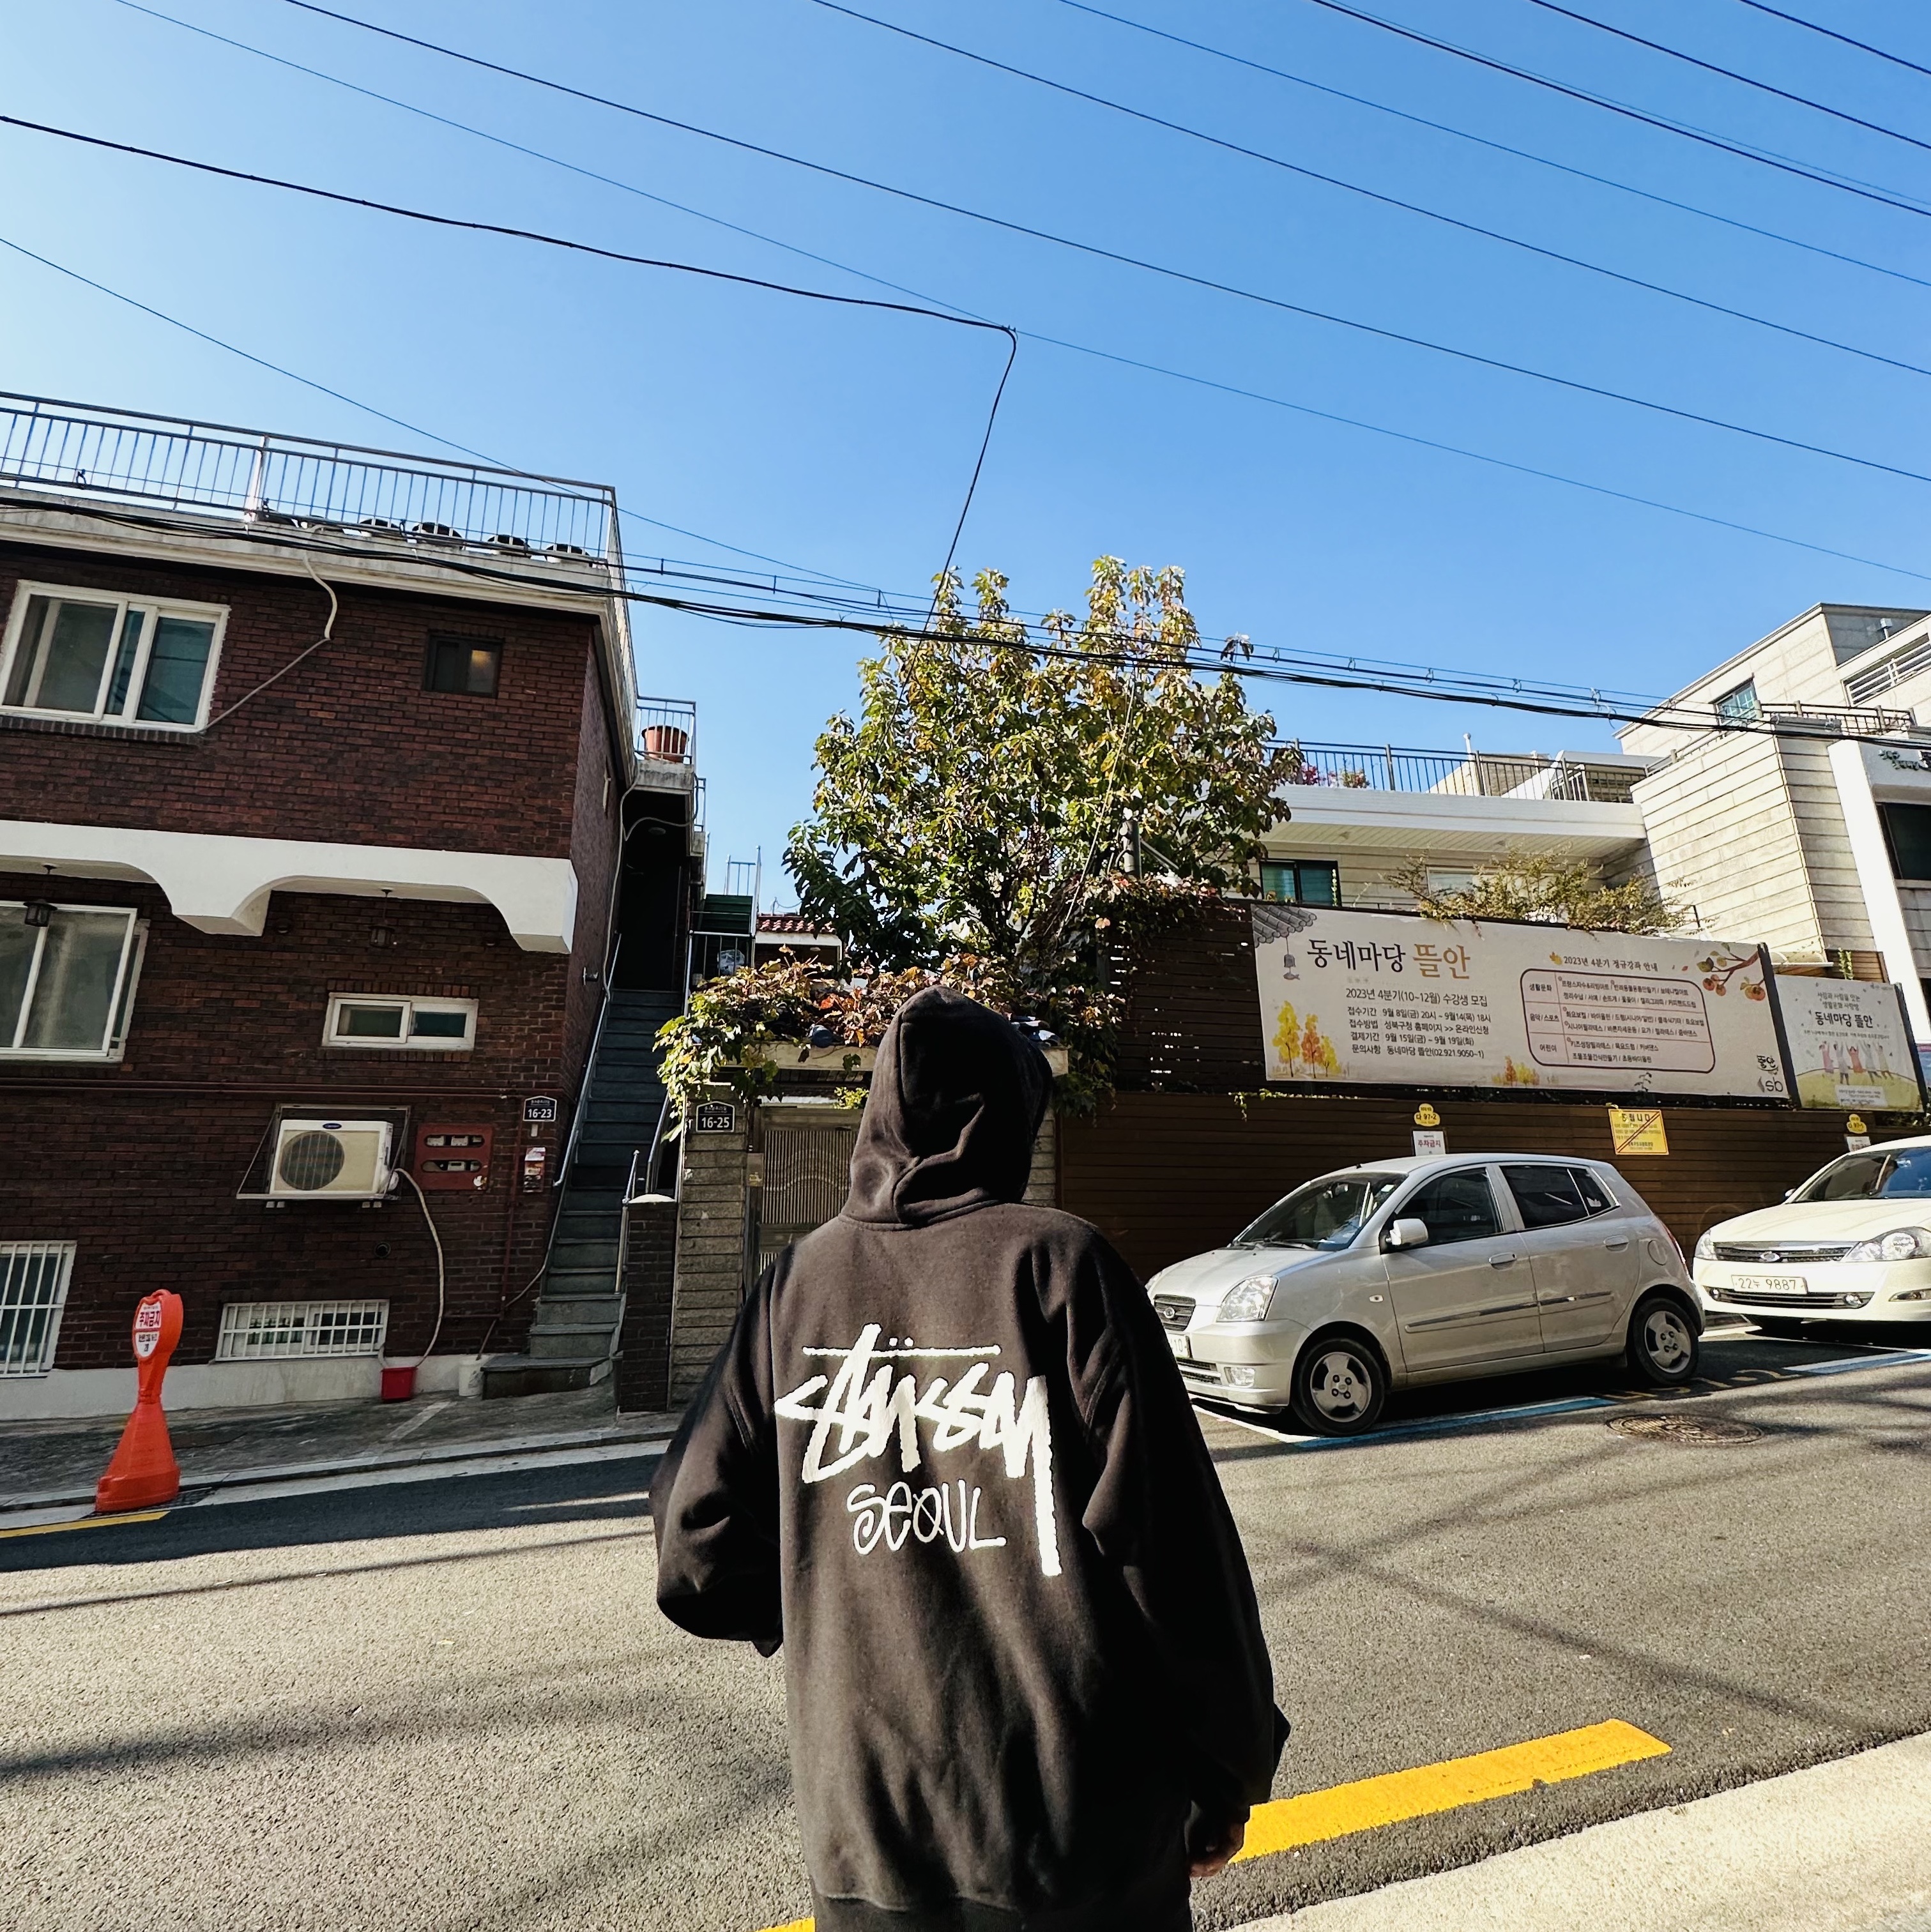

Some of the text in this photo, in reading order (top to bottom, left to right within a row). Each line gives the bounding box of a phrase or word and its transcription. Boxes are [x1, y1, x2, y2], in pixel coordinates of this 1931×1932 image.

[1307, 939, 1470, 979] 동네마당 뜰안
[1563, 955, 1658, 972] 2023년 4분기 정규강좌 안내
[1345, 988, 1488, 1007] 2023년 4분기(10~12월) 수강생 모집
[1347, 1007, 1377, 1016] 접수기간
[1382, 1008, 1394, 1017] 9월
[1396, 1008, 1419, 1019] 8일(금)
[1421, 1010, 1437, 1020] 20시
[1477, 1014, 1491, 1023] 18시
[1815, 1011, 1874, 1028] 동네마당 뜰안
[1349, 1019, 1378, 1029] 접수방법
[1384, 1021, 1412, 1030] 성북구청
[1415, 1023, 1442, 1032] 홈페이지
[1456, 1024, 1489, 1035] 온라인신청
[1385, 1033, 1397, 1042] 9월
[1399, 1033, 1426, 1044] 15일(금)
[1435, 1036, 1446, 1045] 9월
[1448, 1037, 1474, 1046] 19일(화)
[1352, 1044, 1381, 1054] 문의사항
[1387, 1046, 1416, 1056] 동네마당
[1539, 1044, 1557, 1053] 어린이
[528, 1109, 552, 1118] 16-23
[701, 1116, 730, 1129] 16-25
[1417, 1139, 1441, 1148] 주차금지
[1766, 1279, 1796, 1291] 9887
